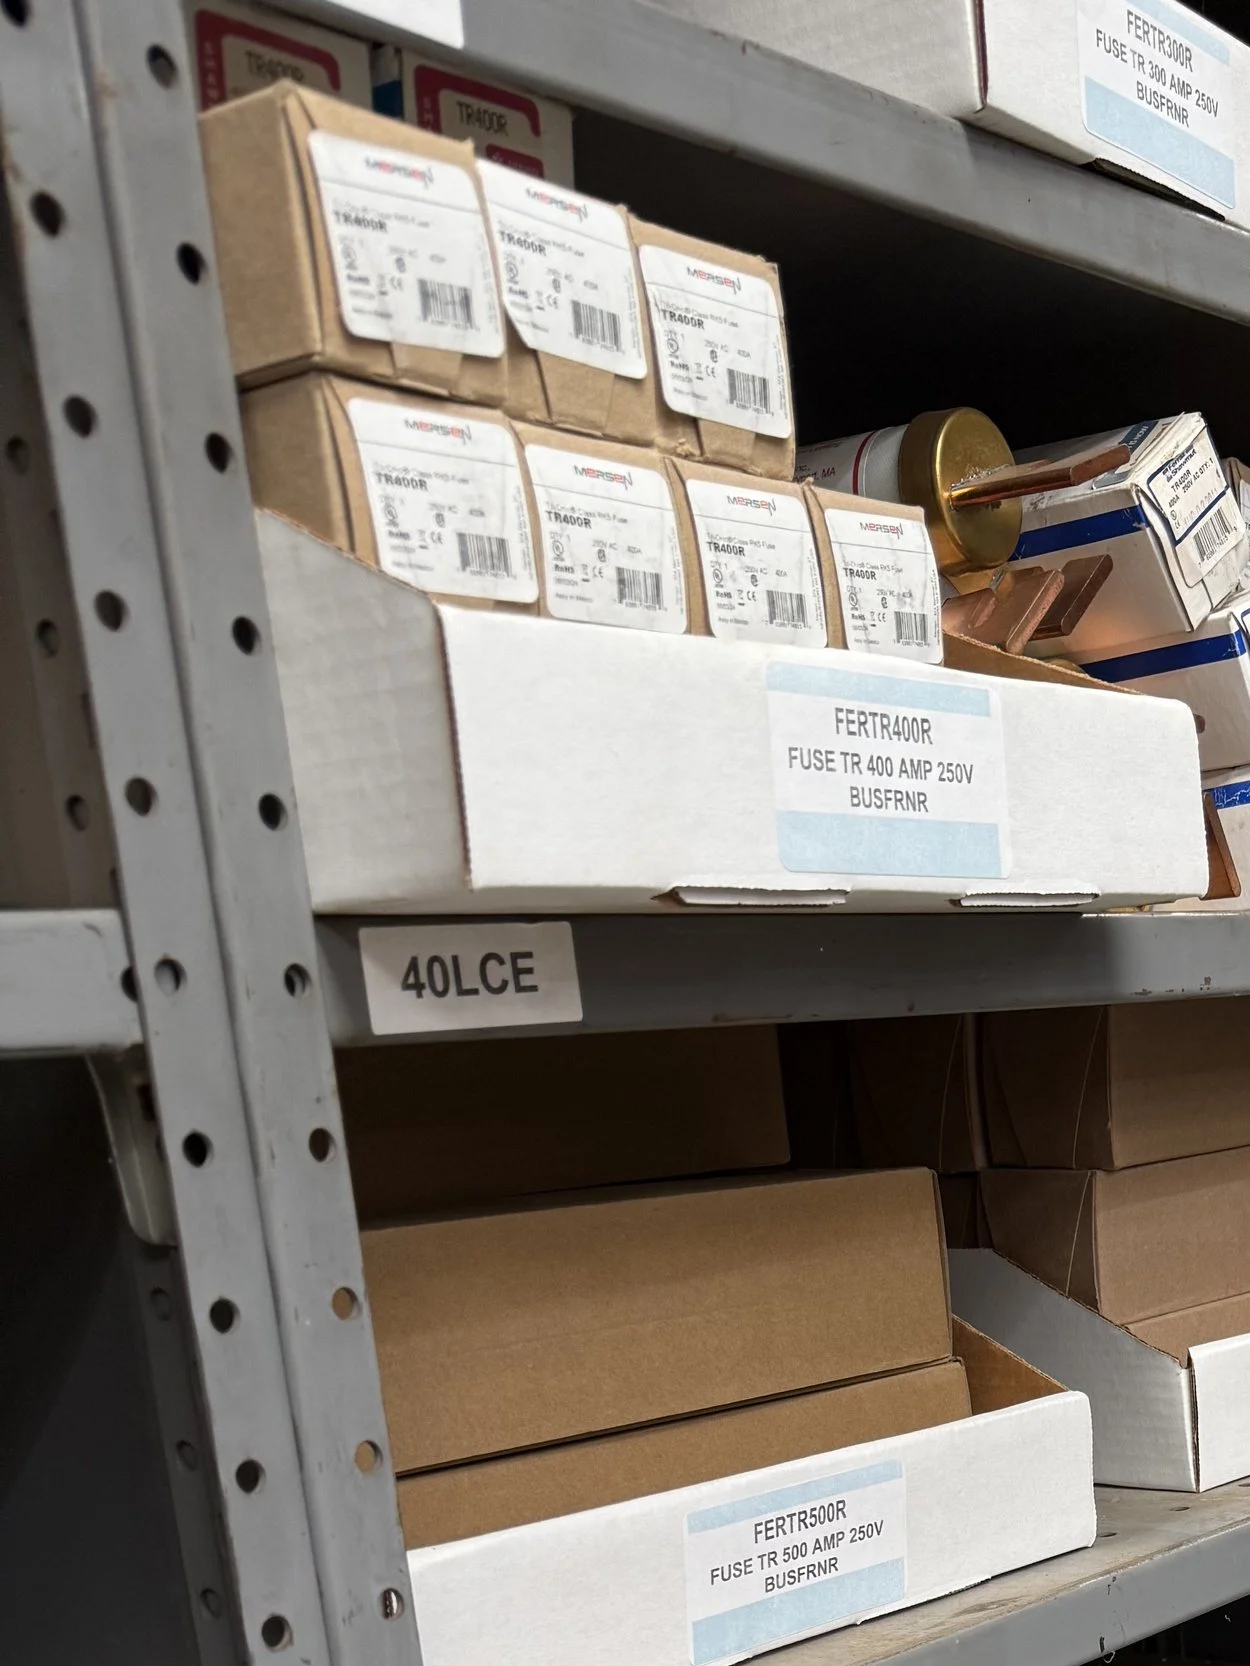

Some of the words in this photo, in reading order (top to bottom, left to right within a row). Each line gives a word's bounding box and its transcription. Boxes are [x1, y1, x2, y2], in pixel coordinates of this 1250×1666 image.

[1127, 9, 1193, 72] FERTR300R
[1096, 29, 1127, 62] FUSE
[1131, 50, 1146, 75] TR
[1148, 61, 1166, 86] 300
[1169, 74, 1193, 99] AMP
[1195, 89, 1218, 117] 250V
[1136, 81, 1189, 127] BUSFRNR
[457, 102, 508, 136] TR400R
[335, 211, 388, 233] TR400R
[500, 230, 546, 257] TR400R
[687, 266, 741, 294] MERSEN
[661, 309, 705, 330] TR400R
[375, 471, 428, 492] TR400R
[574, 465, 633, 490] MERSEN
[1171, 469, 1191, 491] TR400R
[727, 495, 776, 515] MERSEN
[547, 510, 592, 529] TR400R
[860, 521, 903, 540] MERSEN
[706, 541, 745, 557] TR400R
[843, 568, 877, 581] TR400R
[835, 707, 933, 744] FERTR400R
[789, 747, 836, 771] FUSE
[840, 751, 862, 774] TR
[867, 755, 893, 777] 400
[898, 758, 933, 781] AMP
[937, 762, 973, 783] 250V
[850, 786, 928, 812] BUSFRNR
[401, 951, 539, 999] 40LCE
[754, 1499, 847, 1544] FERTR500R
[710, 1558, 754, 1586] FUSE
[757, 1552, 778, 1572] TR
[783, 1543, 808, 1566] 500
[812, 1532, 845, 1556] AMP
[849, 1520, 884, 1545] 250V
[764, 1557, 839, 1594] BUSFRNR
